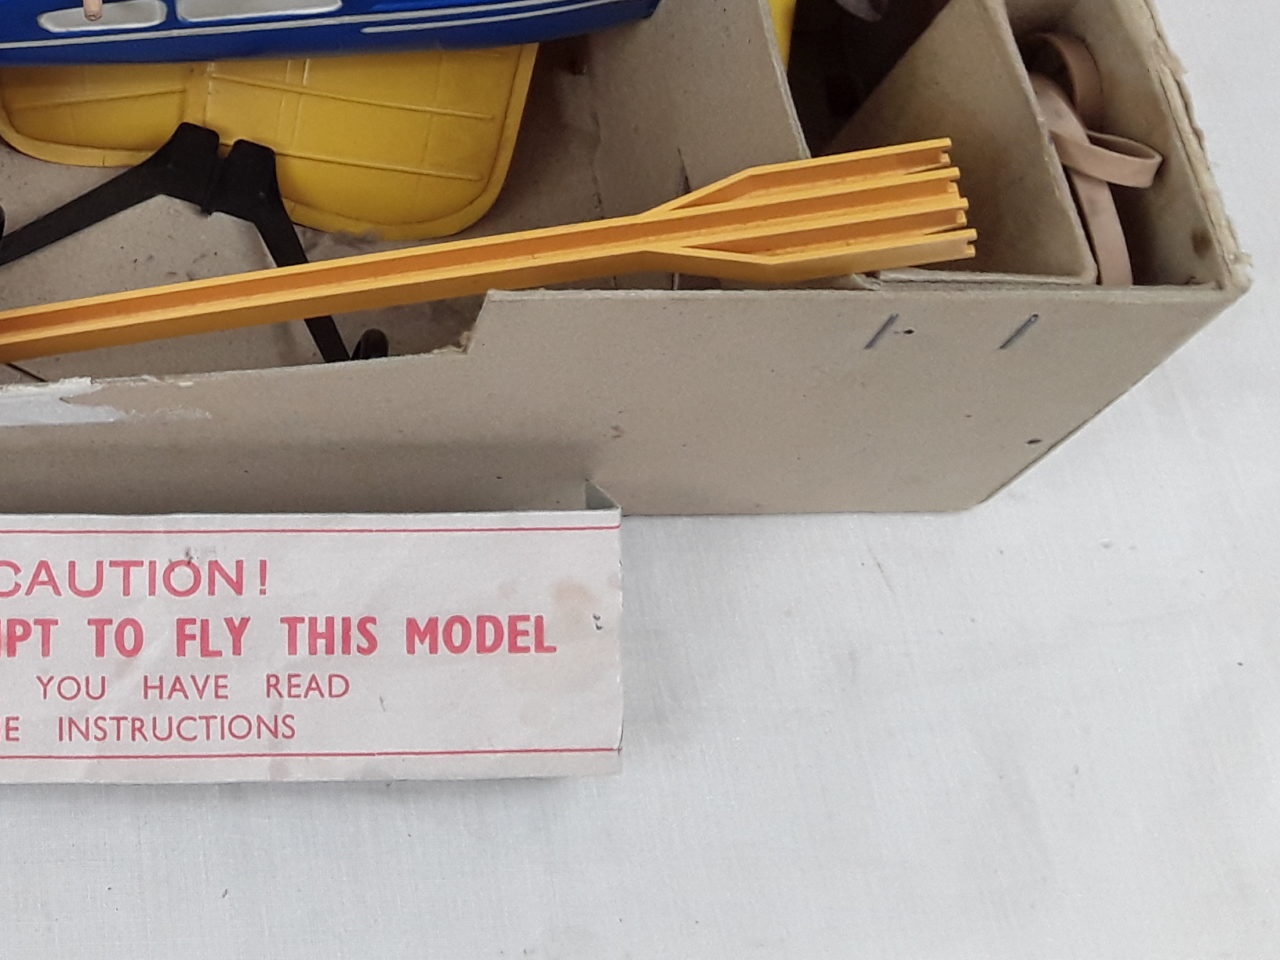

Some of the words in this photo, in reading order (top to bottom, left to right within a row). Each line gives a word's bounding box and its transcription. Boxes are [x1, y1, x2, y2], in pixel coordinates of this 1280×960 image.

[86, 617, 145, 659] TO
[175, 616, 252, 659] FLY
[279, 615, 379, 657] THIS
[405, 613, 558, 656] MODEL
[36, 675, 108, 702] YOU
[142, 673, 229, 700] HAVE
[265, 672, 351, 700] READ
[58, 713, 296, 742] INSTRUCTIONS
